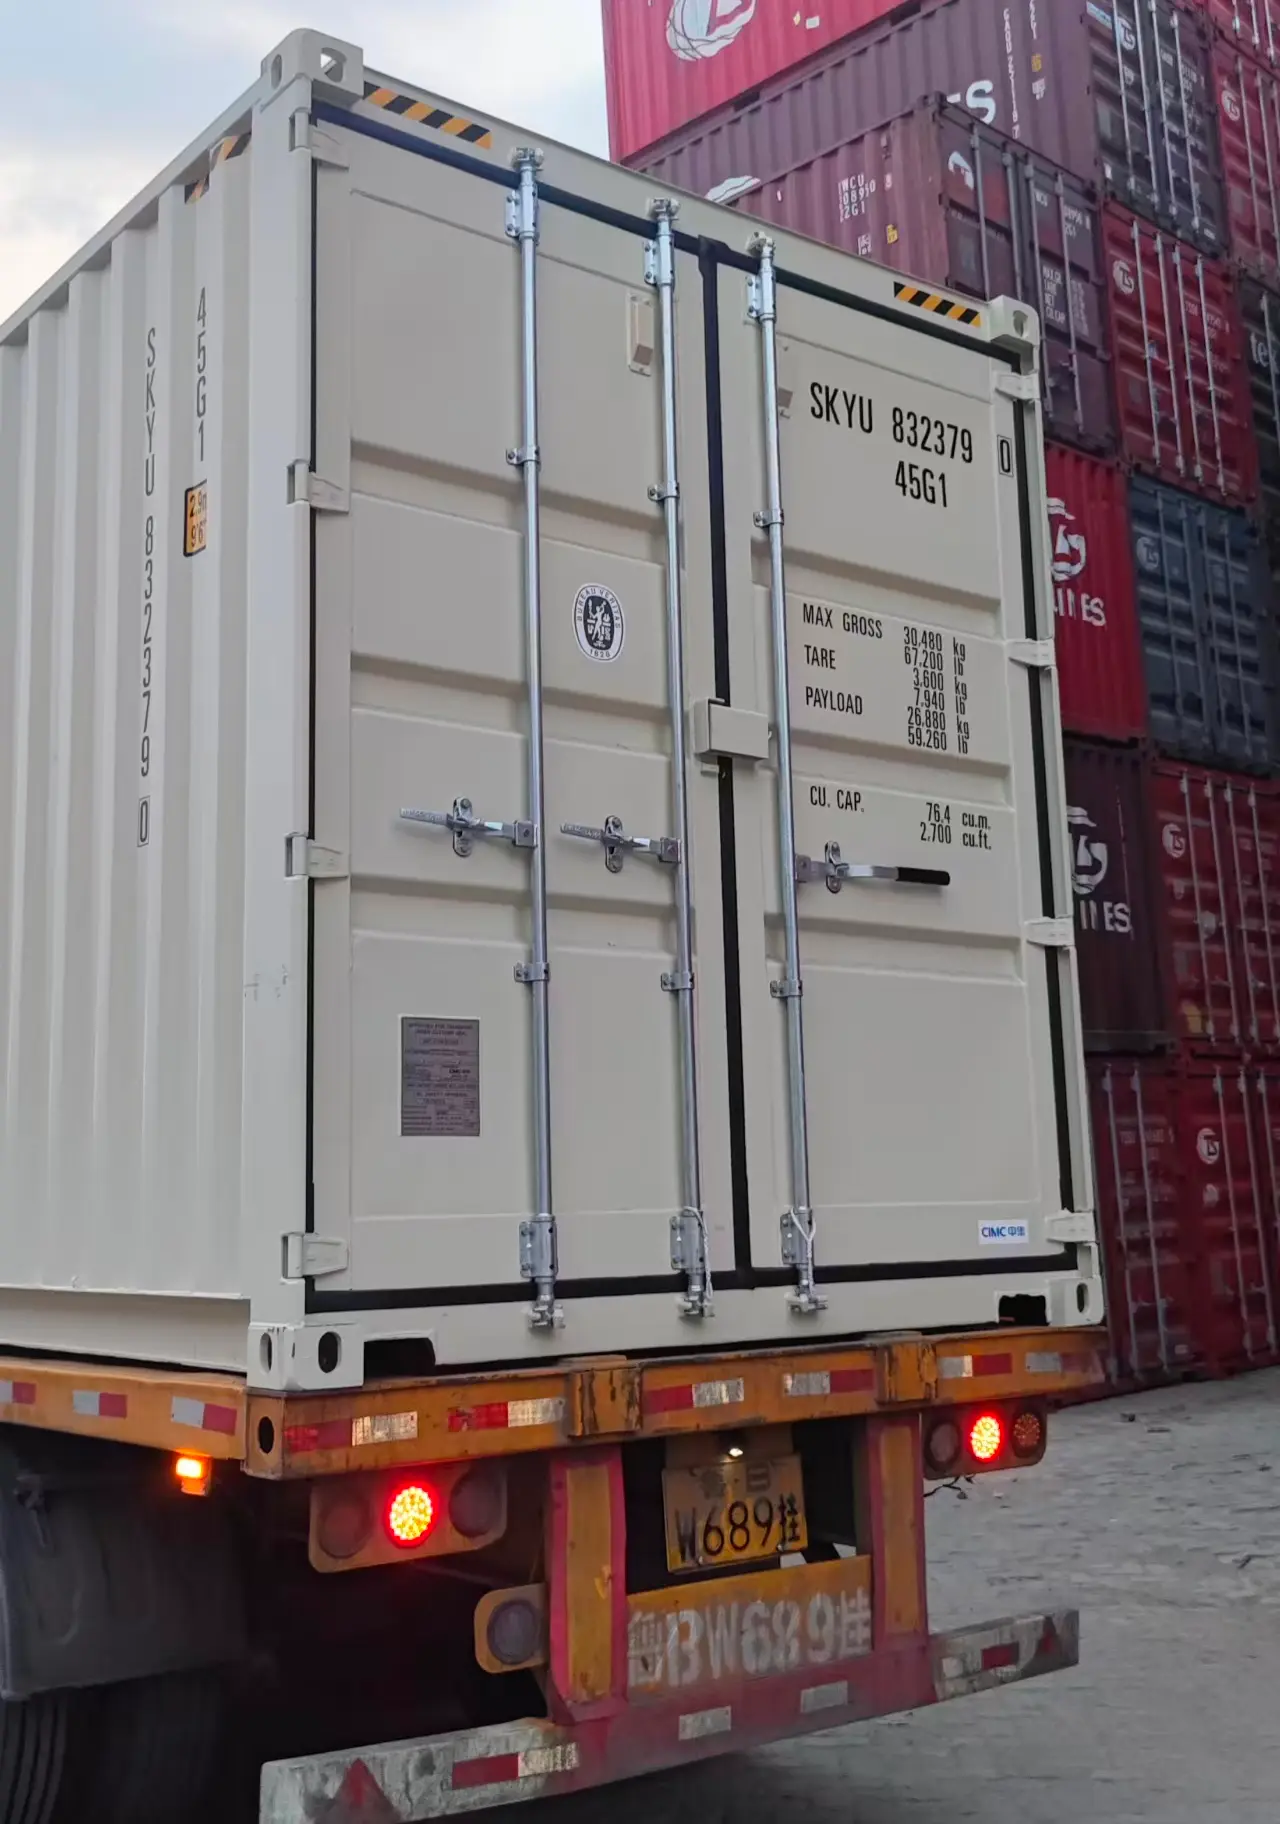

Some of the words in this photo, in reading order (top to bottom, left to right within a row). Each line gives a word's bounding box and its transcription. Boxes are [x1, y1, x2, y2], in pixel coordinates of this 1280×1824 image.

[946, 80, 996, 125] S
[197, 286, 206, 462] 45G1
[146, 327, 156, 497] SKYU
[810, 382, 873, 434] SKYU
[892, 407, 973, 464] 832379
[1000, 439, 1011, 473] 0
[895, 460, 948, 507] 45G1
[140, 515, 154, 778] 832379
[803, 603, 834, 629] MAX
[842, 612, 883, 639] GROSS
[953, 637, 966, 662] kg
[804, 644, 837, 670] TARE
[954, 677, 968, 701] kg
[954, 657, 964, 676] lb
[805, 686, 863, 715] PAYLOAD
[956, 715, 970, 740] kg
[955, 695, 966, 715] lb
[957, 735, 968, 755] lb
[810, 786, 831, 807] CU.
[836, 789, 865, 812] CAP.
[926, 802, 951, 824] 76.4
[981, 1226, 1006, 1238] CIMC
